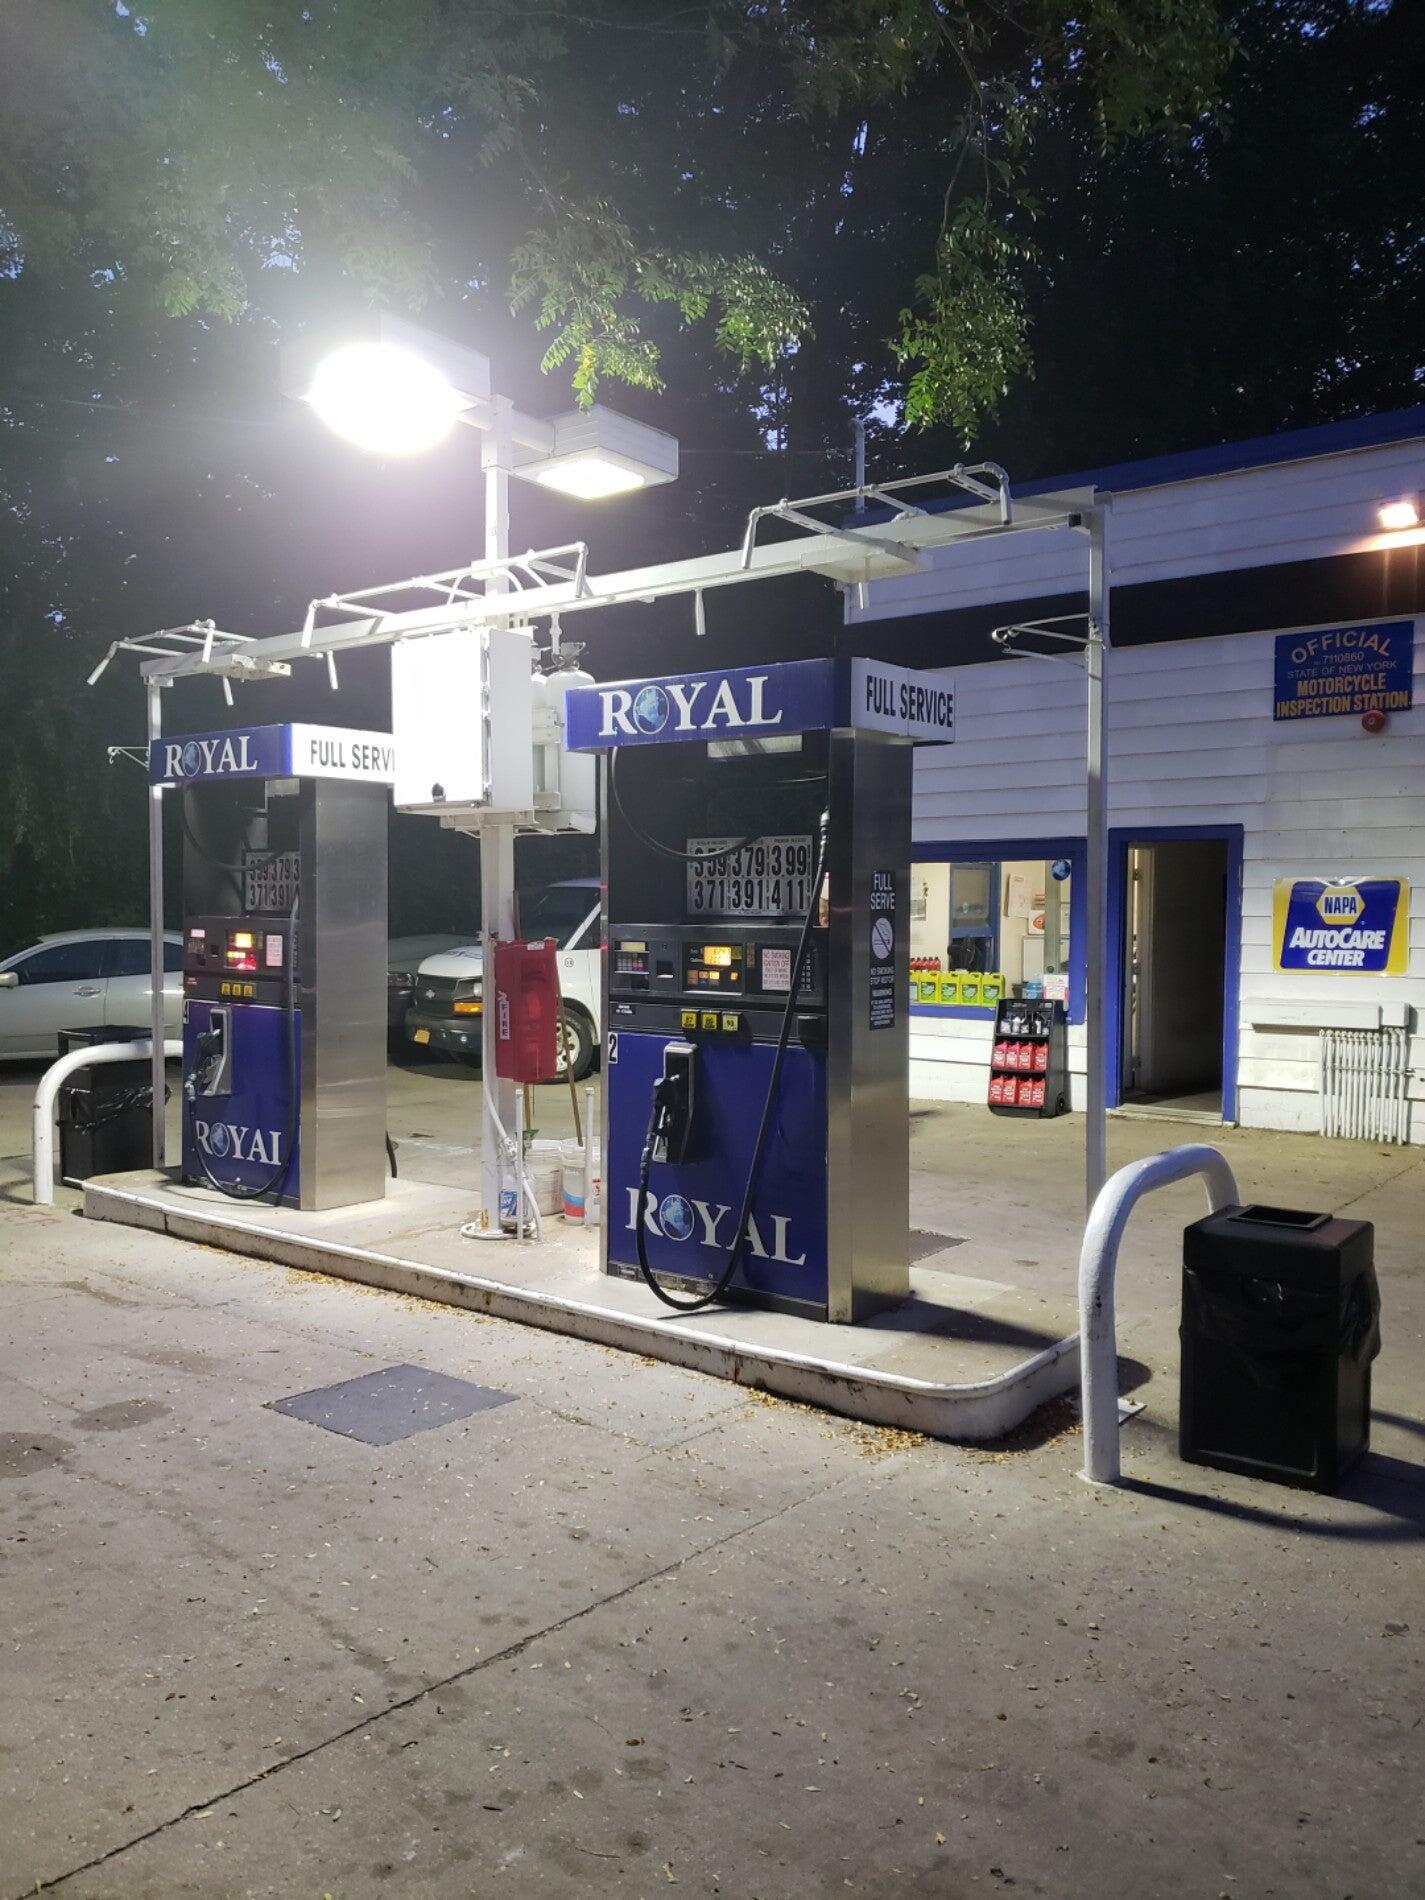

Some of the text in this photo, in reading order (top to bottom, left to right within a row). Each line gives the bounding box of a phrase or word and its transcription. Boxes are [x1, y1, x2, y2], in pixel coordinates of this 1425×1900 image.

[1291, 631, 1391, 664] OFFICIAL
[1287, 660, 1397, 680] STATE OF NEW YORK
[1296, 672, 1387, 698] MOTORCYCLE
[598, 676, 783, 737] ROYAL
[866, 674, 954, 728] FULL SERVICE
[1276, 690, 1409, 718] INSPECTION STATION
[163, 735, 258, 778] ROYAL
[311, 739, 395, 773] FULL SERVI
[873, 873, 893, 891] FULL
[870, 892, 896, 910] SERVE
[1324, 896, 1358, 914] NAPA
[1306, 949, 1365, 967] CENTER
[608, 1033, 617, 1063] 2
[625, 1187, 807, 1266] ROYAL
